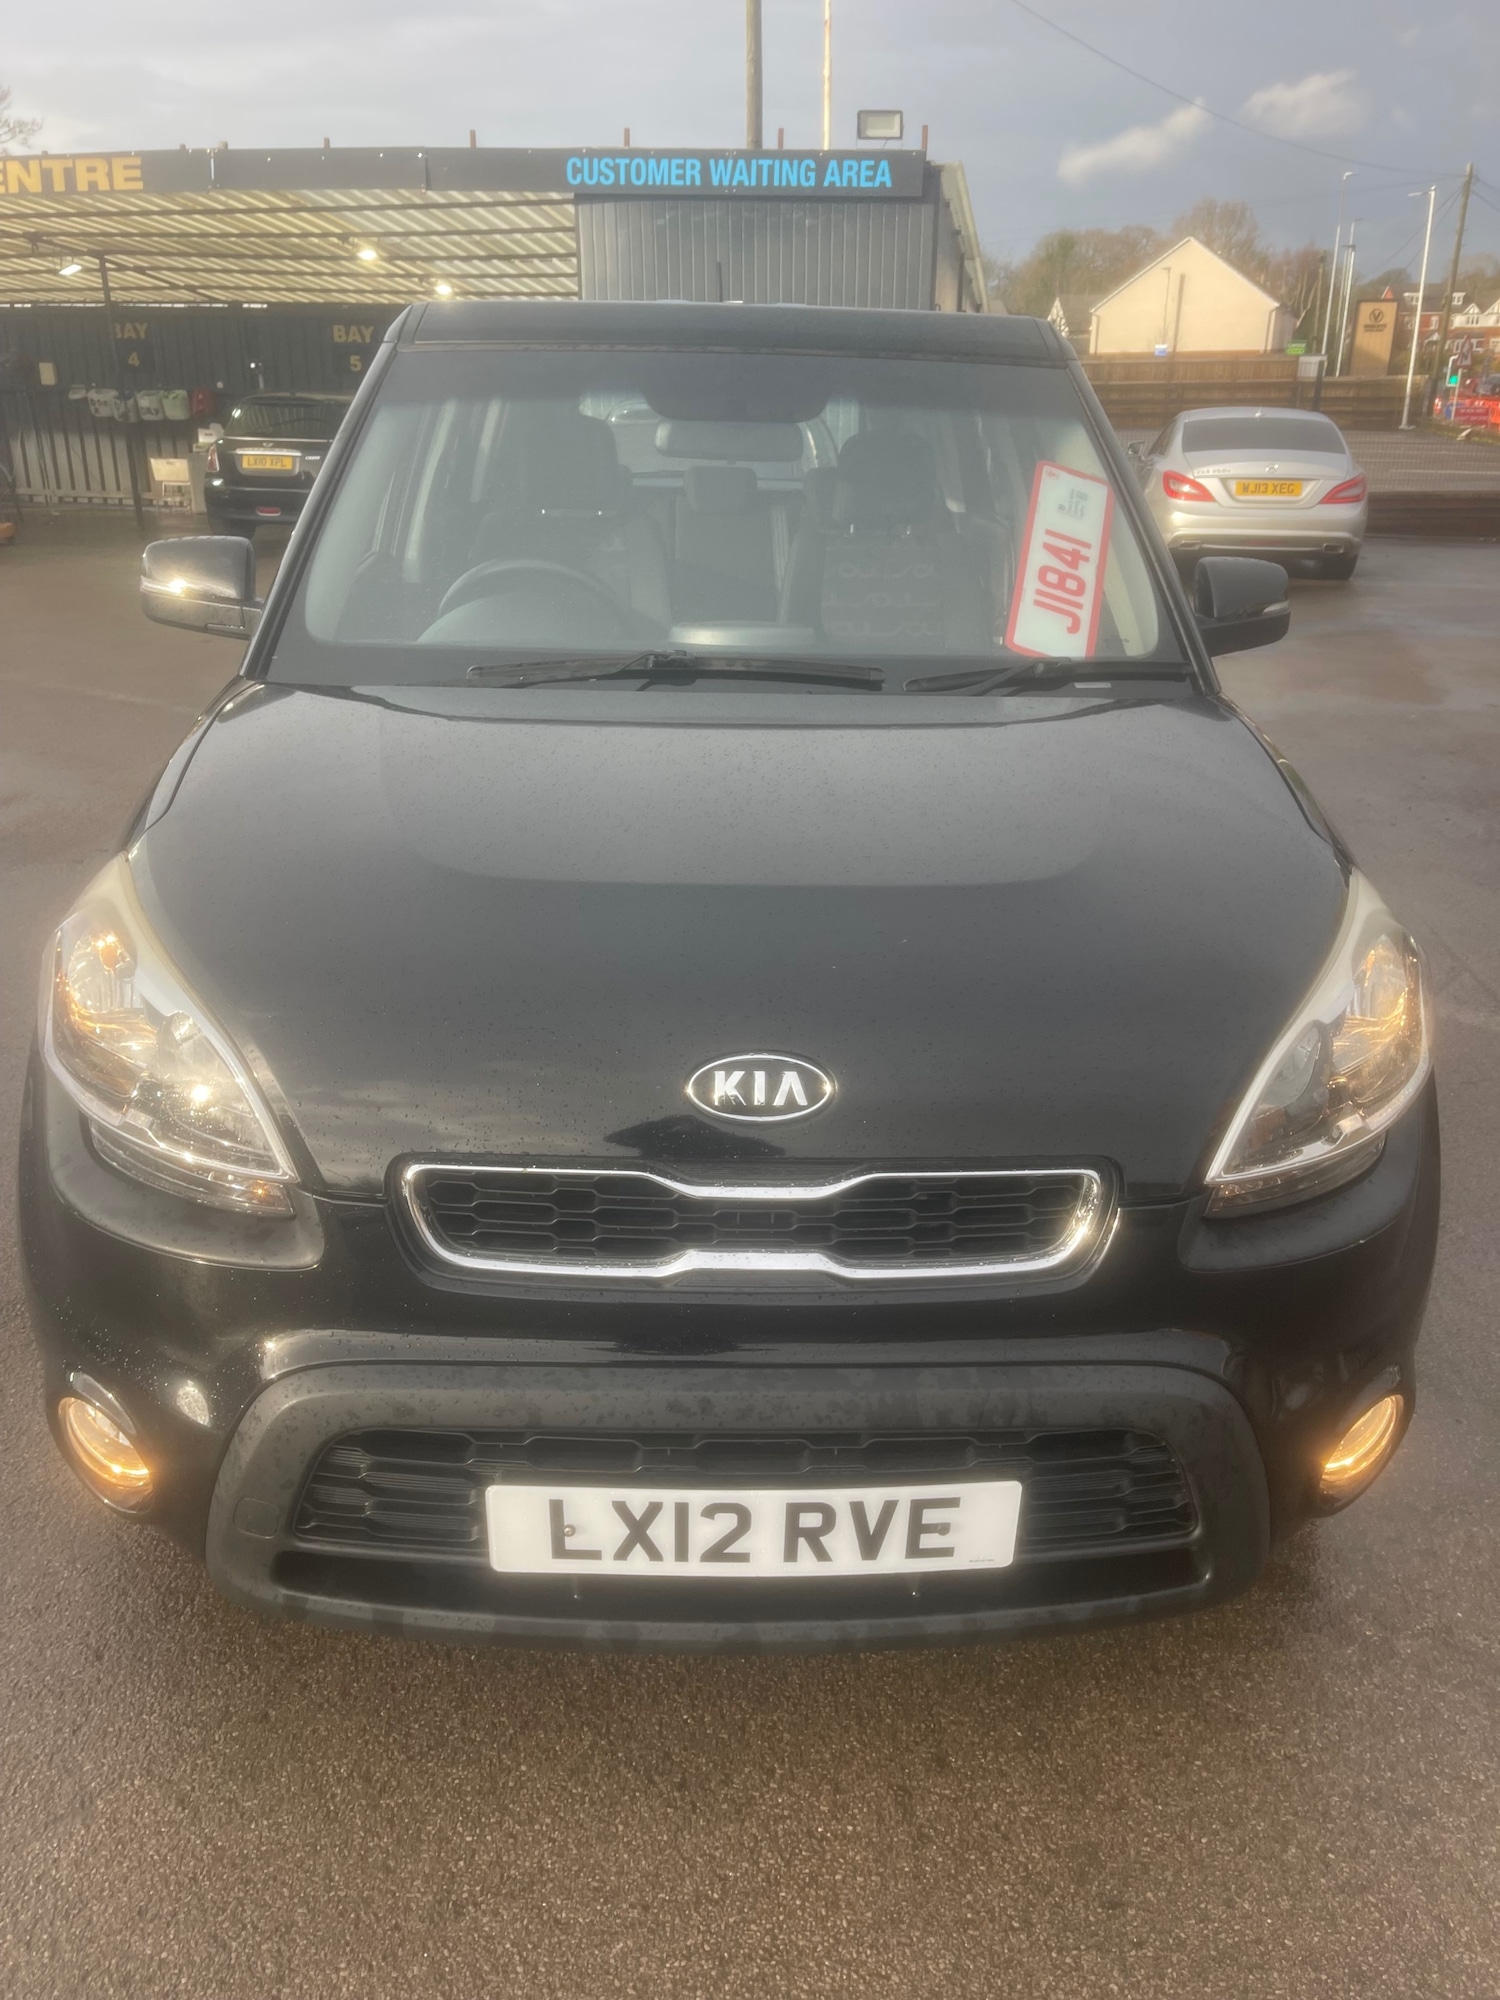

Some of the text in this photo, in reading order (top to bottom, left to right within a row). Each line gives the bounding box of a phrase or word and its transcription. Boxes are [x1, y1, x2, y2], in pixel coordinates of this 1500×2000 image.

[0, 156, 144, 194] NTRE
[566, 157, 893, 188] CUSTOMER WAITING AREA
[333, 324, 374, 343] BAY
[128, 352, 140, 367] 4
[350, 355, 362, 372] 5
[714, 1070, 808, 1106] KIA
[548, 1497, 961, 1563] LX12 RVE
